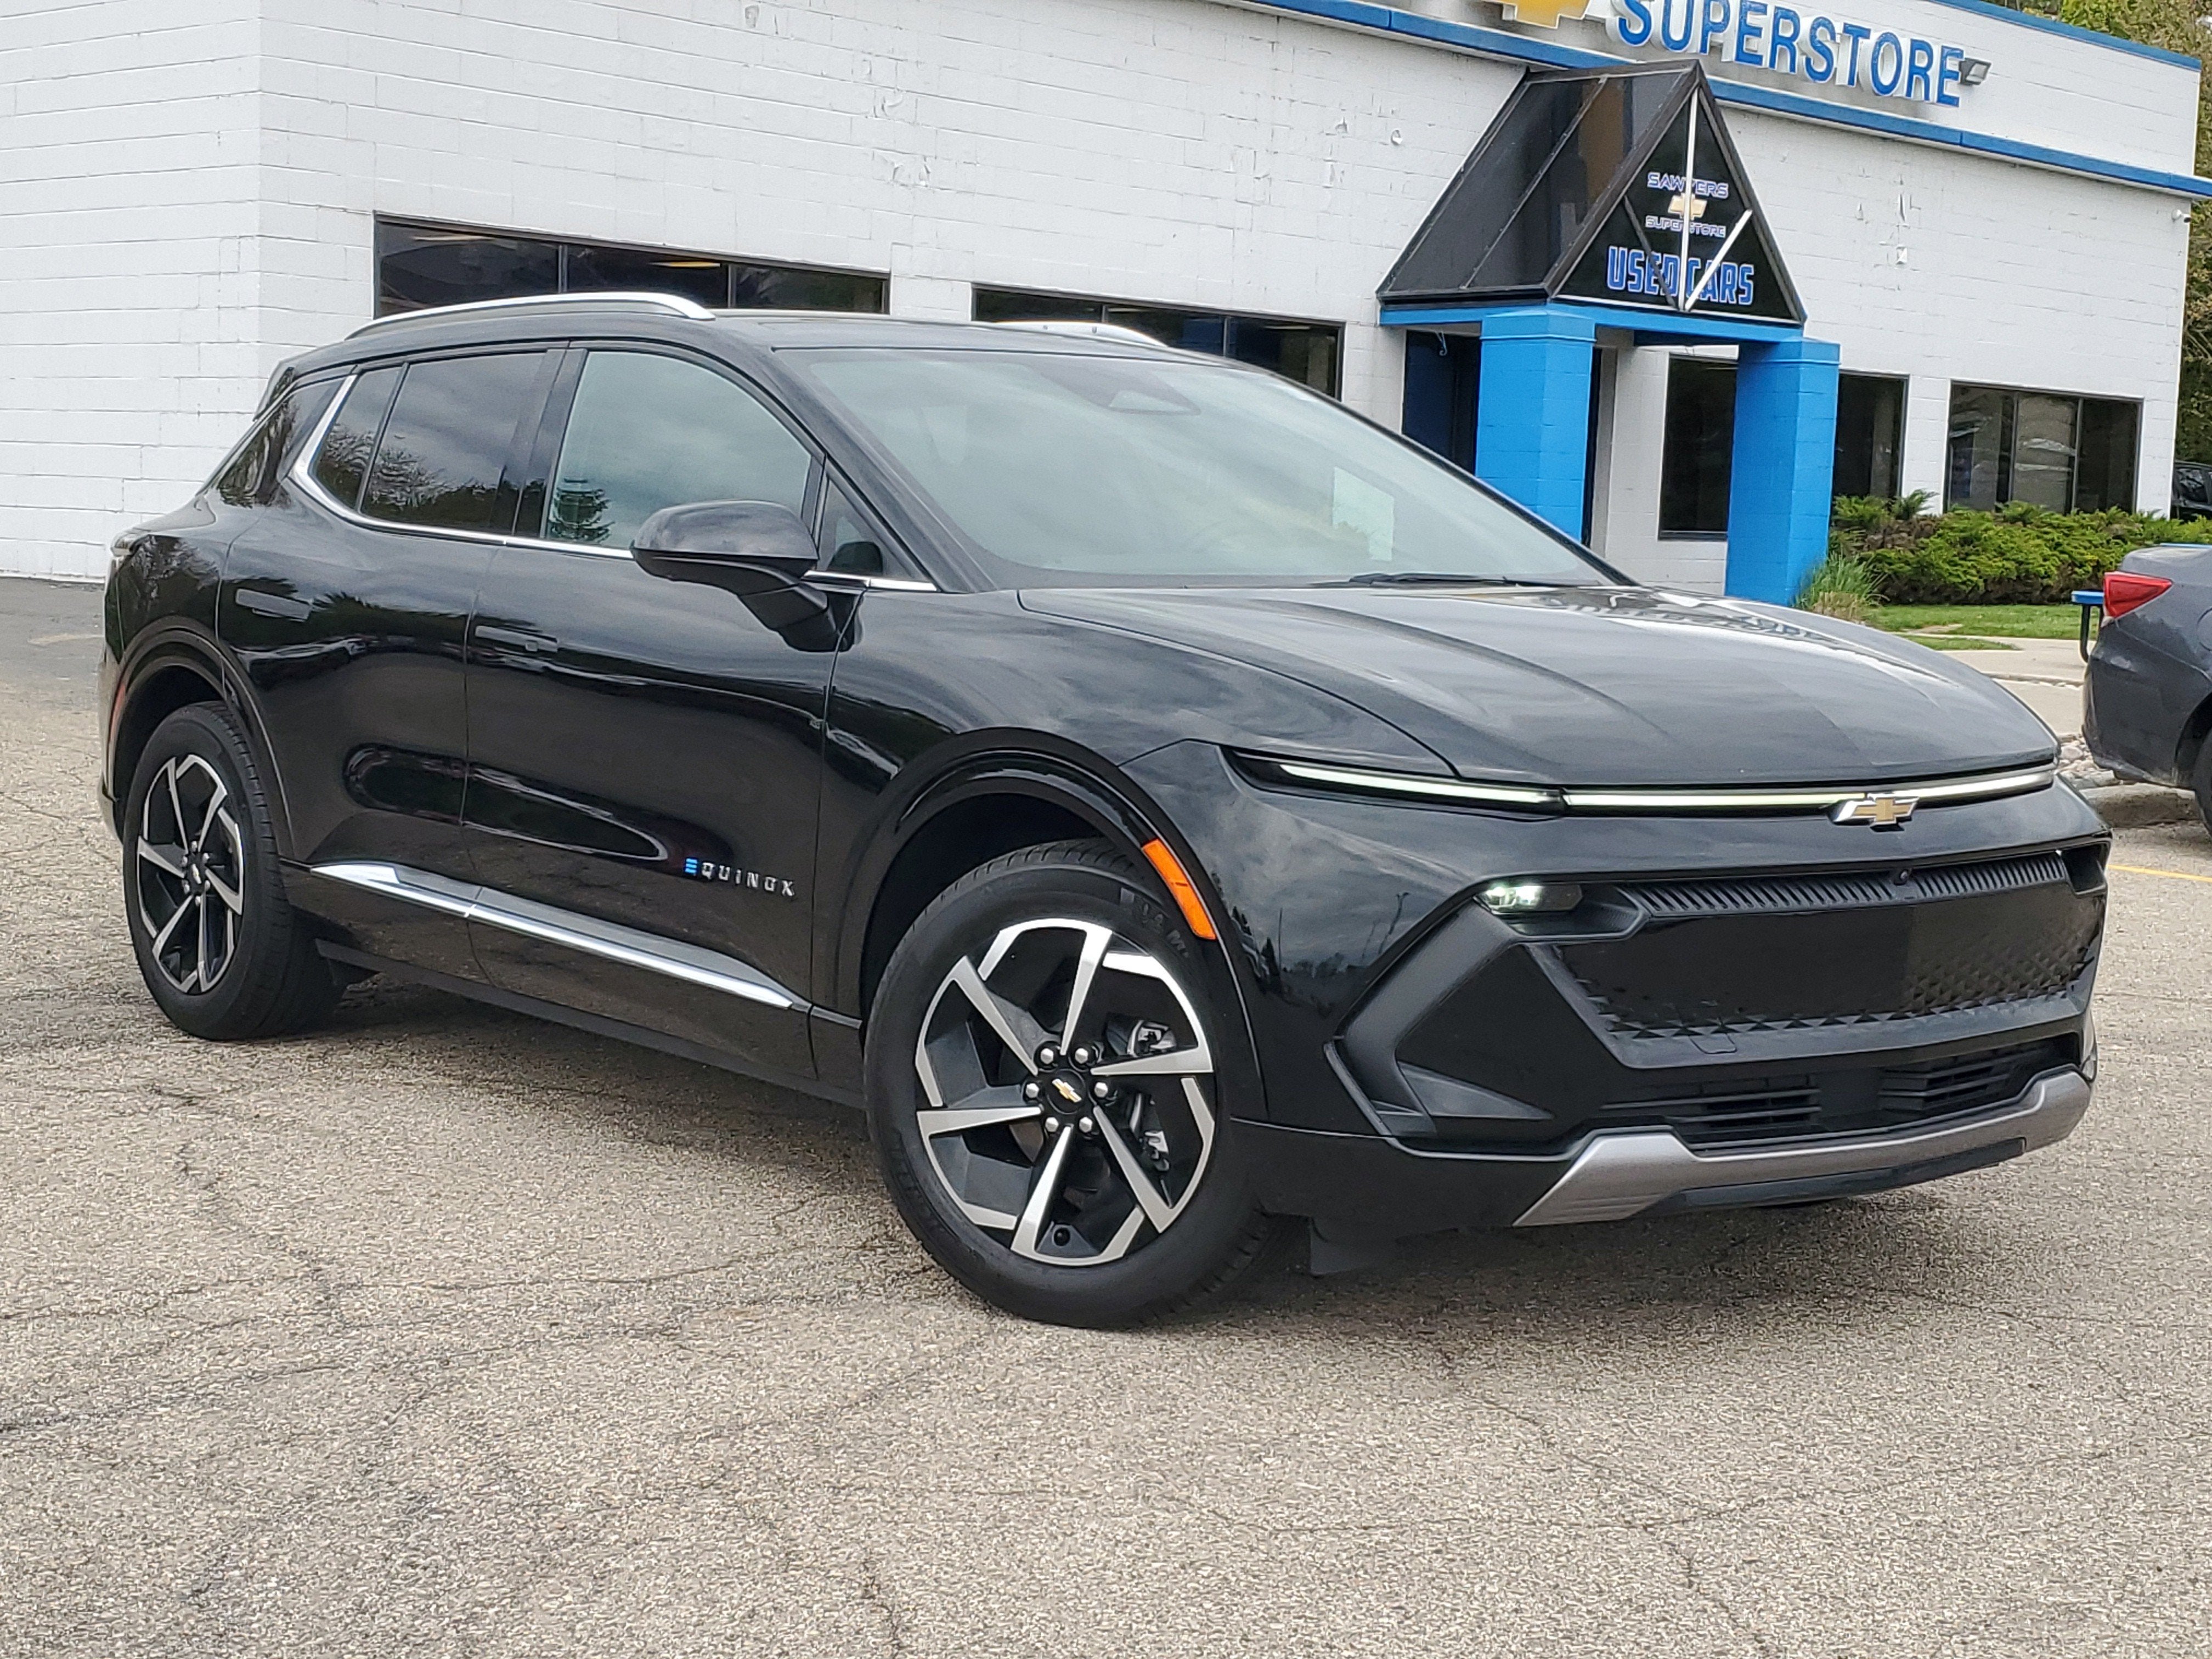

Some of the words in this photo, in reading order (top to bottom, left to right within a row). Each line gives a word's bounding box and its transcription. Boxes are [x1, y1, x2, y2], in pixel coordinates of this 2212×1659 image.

[1617, 0, 1964, 108] SUPERSTORE
[1607, 245, 1680, 297] USED
[1686, 257, 1754, 305] CARS
[685, 857, 795, 896] EQUINOX
